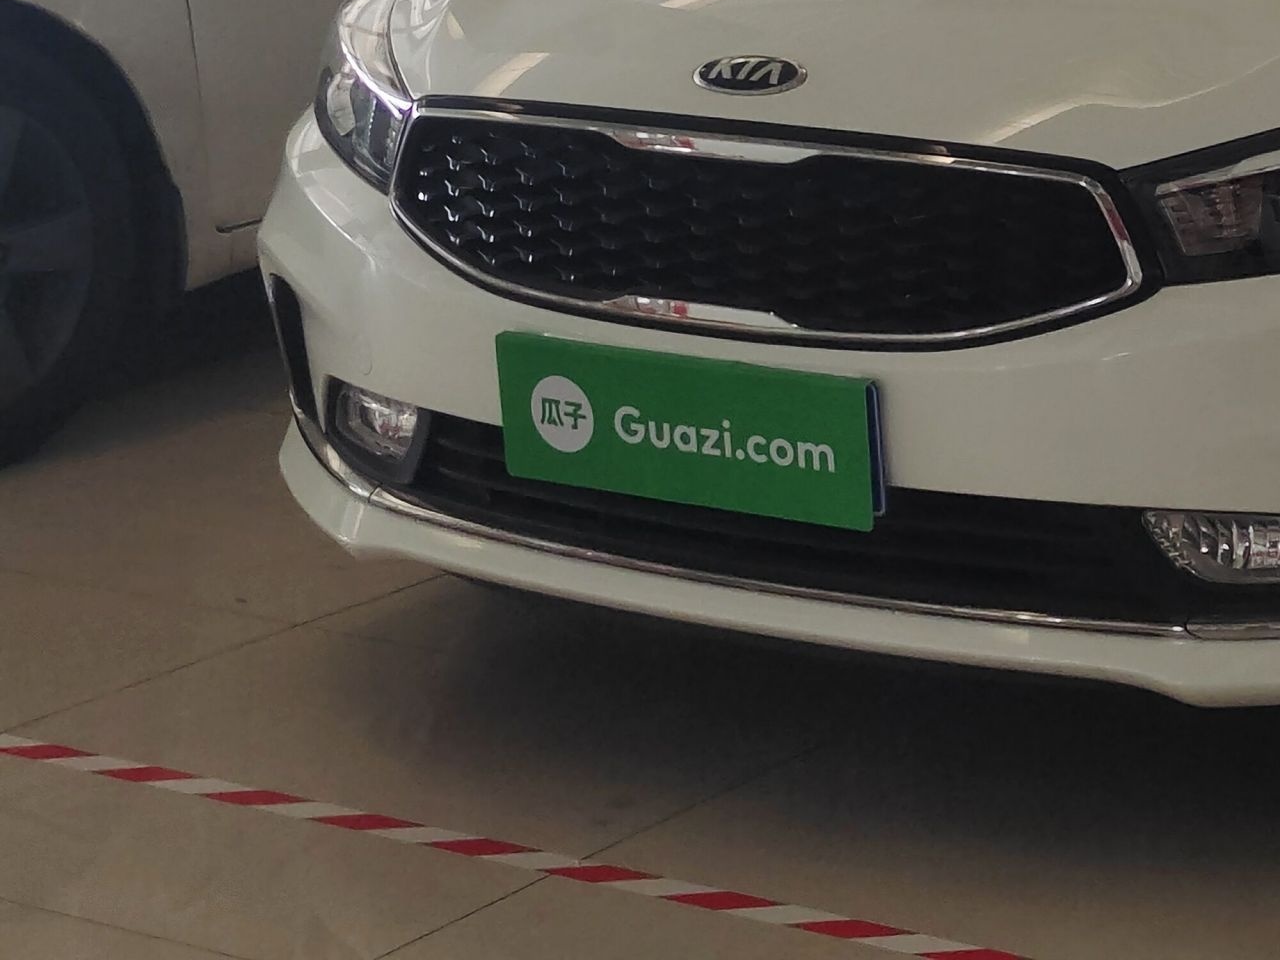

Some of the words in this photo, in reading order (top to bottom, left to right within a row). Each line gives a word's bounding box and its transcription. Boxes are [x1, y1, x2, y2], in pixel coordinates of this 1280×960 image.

[707, 58, 785, 86] KIA
[539, 396, 588, 431] 瓜子
[613, 404, 837, 474] Guazi.com
